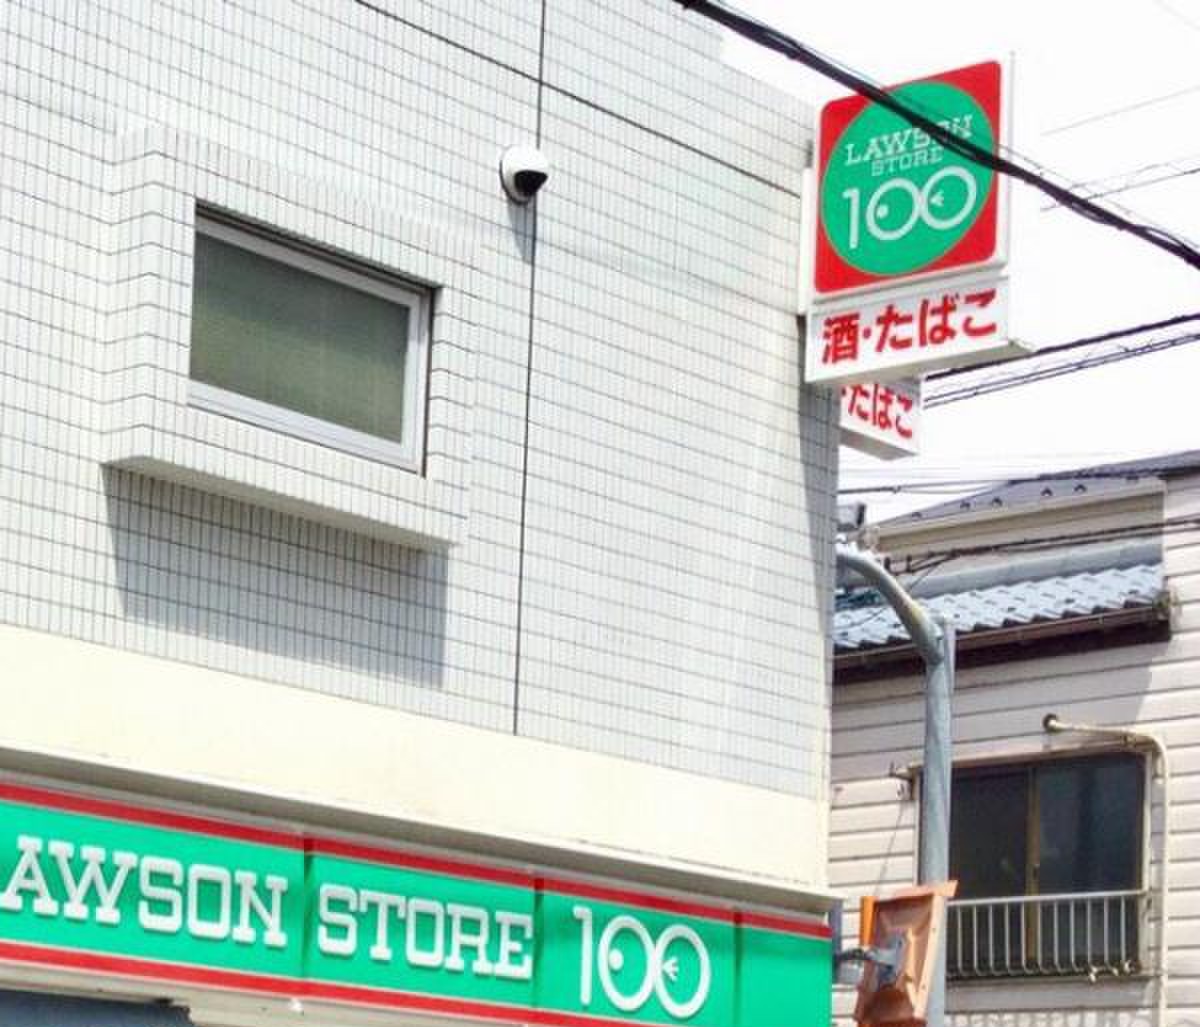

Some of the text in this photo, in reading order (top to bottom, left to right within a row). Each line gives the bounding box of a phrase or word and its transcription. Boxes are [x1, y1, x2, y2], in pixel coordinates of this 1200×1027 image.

[871, 147, 944, 176] STORE
[843, 166, 978, 249] 100
[821, 289, 997, 365] 酒・たばこ
[317, 884, 535, 981] STORE
[571, 905, 712, 1019] 100
